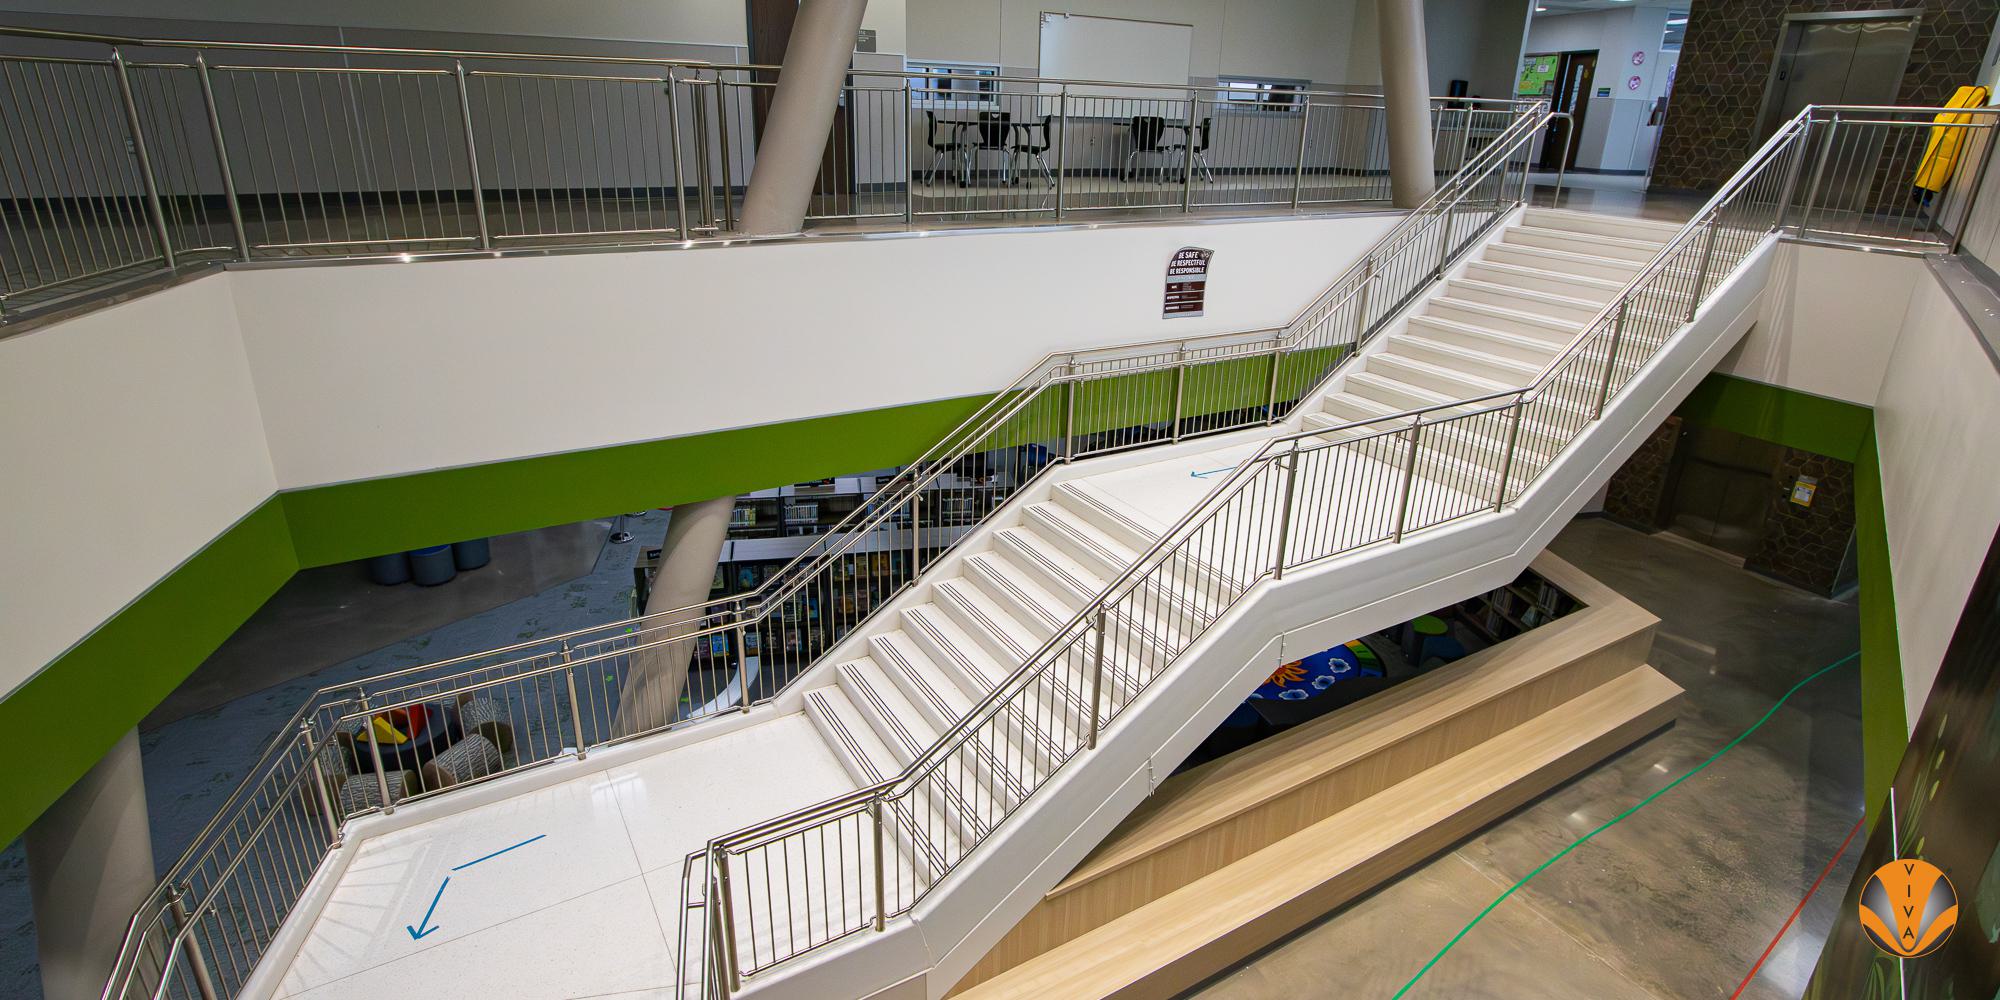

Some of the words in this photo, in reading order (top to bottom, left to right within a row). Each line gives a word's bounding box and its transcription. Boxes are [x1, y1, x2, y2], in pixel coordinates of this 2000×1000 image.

[1178, 251, 1185, 259] BE
[1185, 251, 1199, 259] SAFE
[1177, 259, 1206, 267] RESPECTFUL
